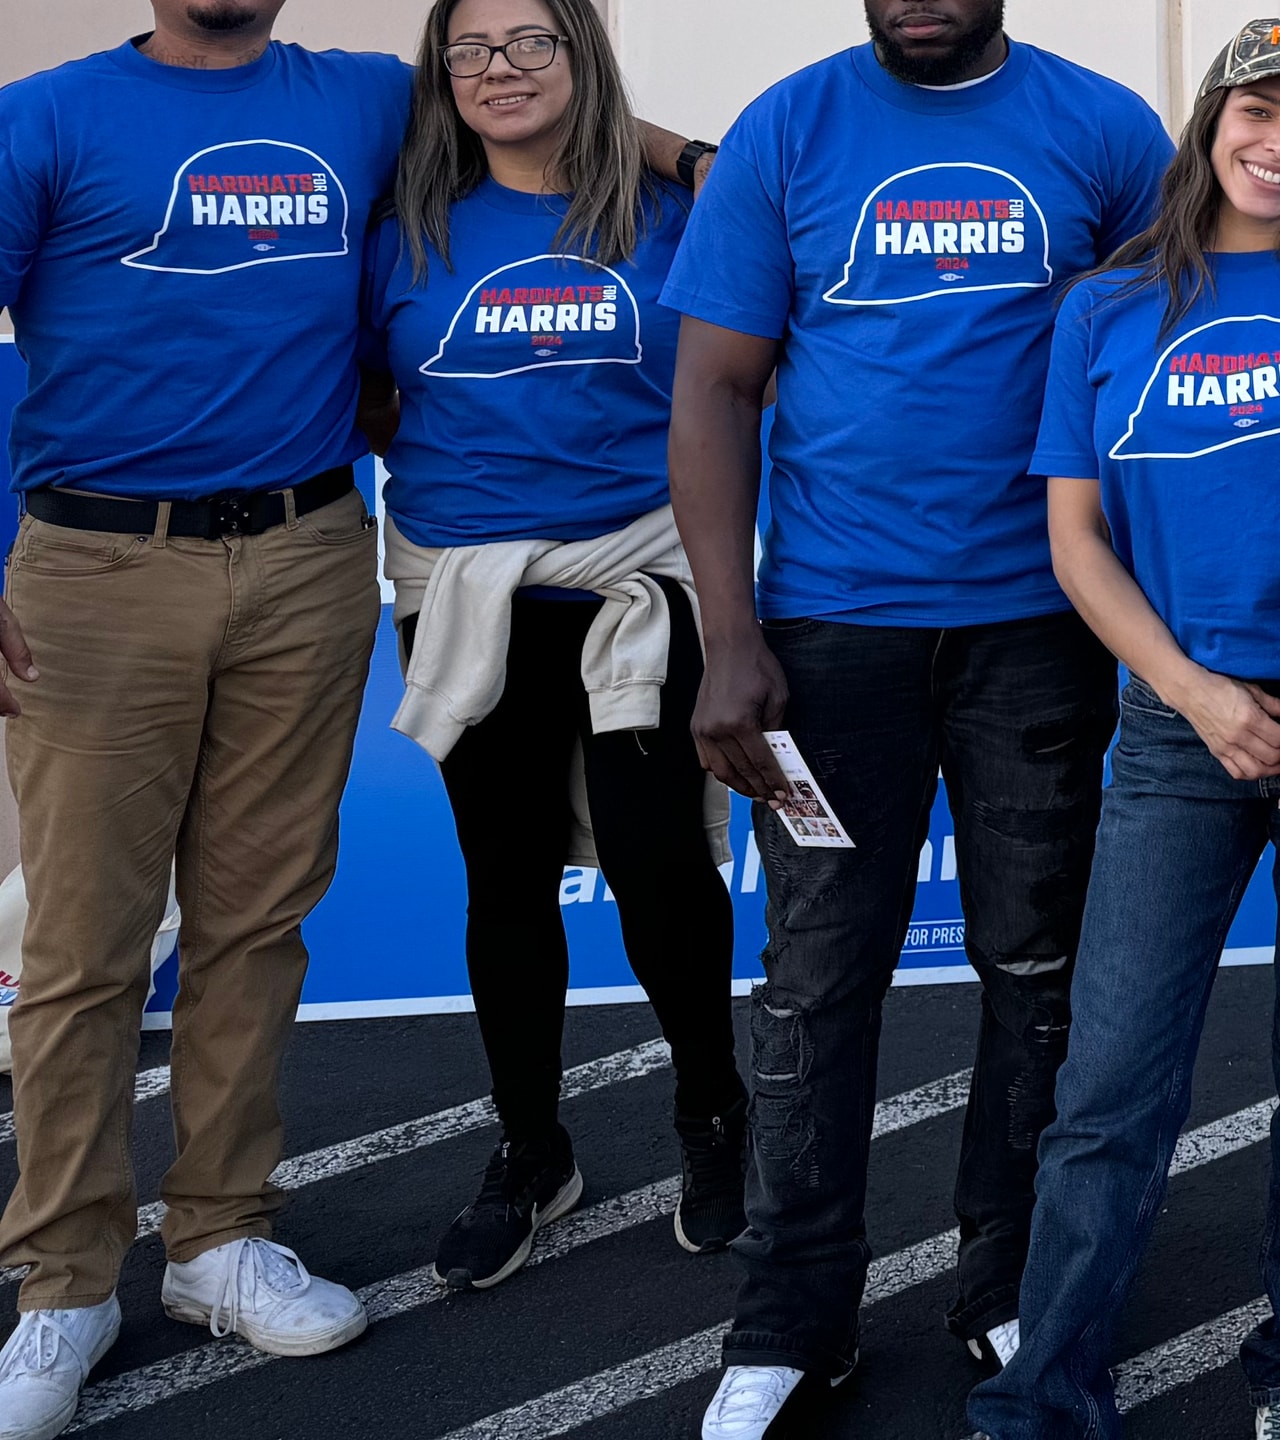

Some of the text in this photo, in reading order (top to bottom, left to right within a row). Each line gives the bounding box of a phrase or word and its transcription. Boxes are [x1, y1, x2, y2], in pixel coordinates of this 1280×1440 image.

[188, 173, 327, 193] HARDHATS FOR
[191, 194, 329, 226] HARRIS
[875, 198, 1024, 221] HARDHATS FOR
[875, 221, 1025, 255] HARRIS
[935, 257, 969, 270] 2024
[479, 285, 603, 305] HARDHATS
[474, 302, 616, 333] HARRIS
[531, 335, 563, 346] 2024
[904, 926, 964, 946] FOR PRES
